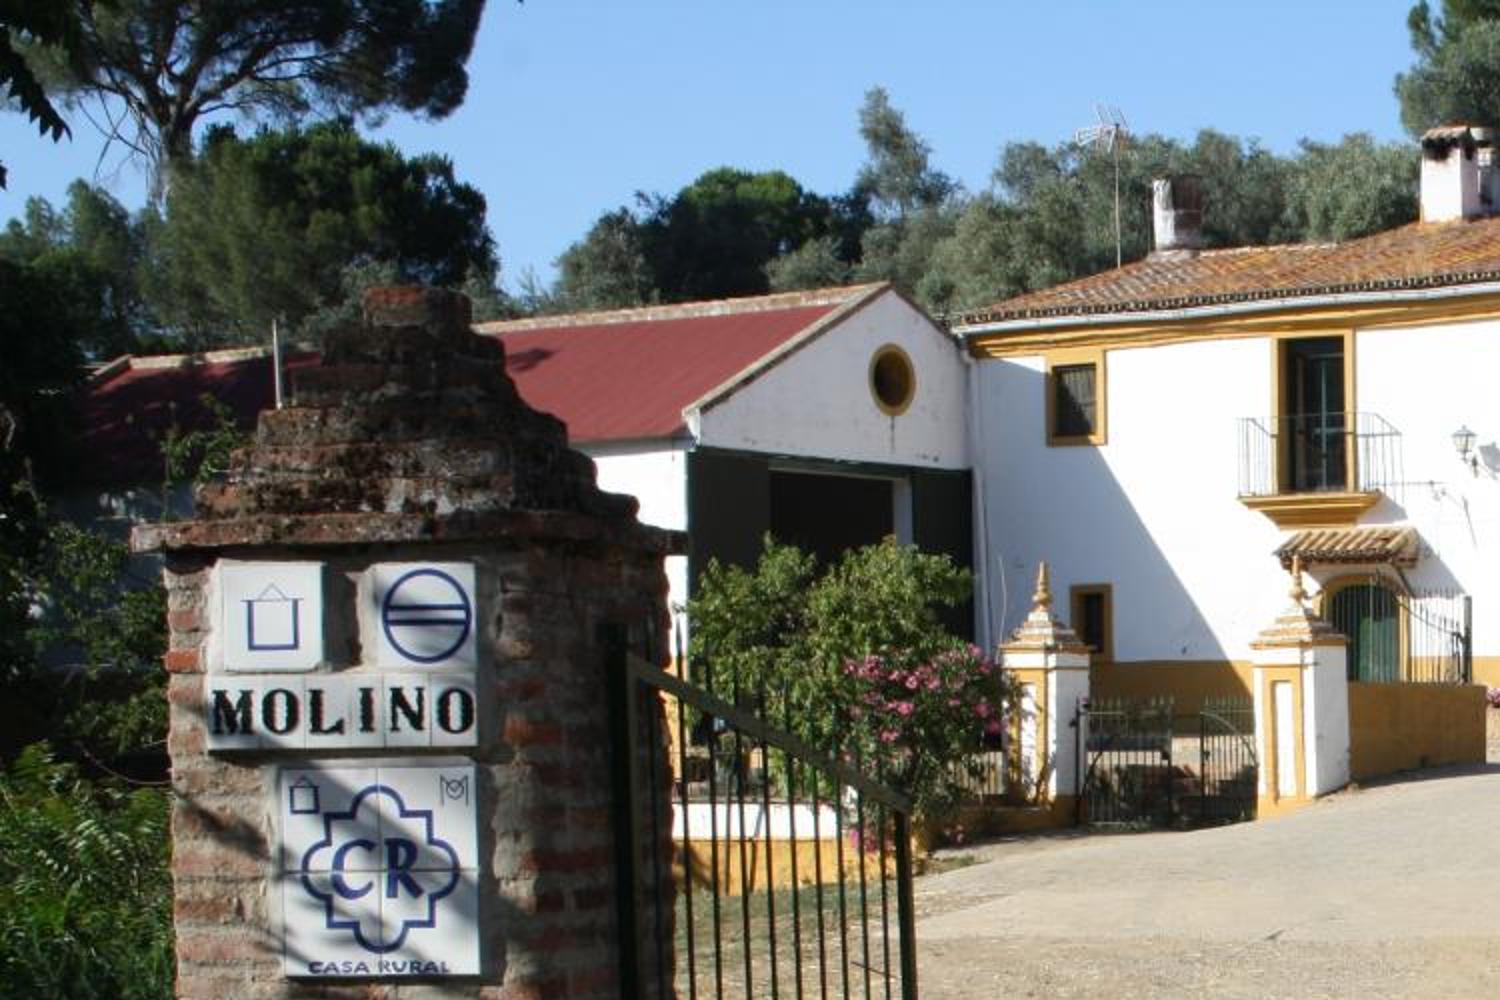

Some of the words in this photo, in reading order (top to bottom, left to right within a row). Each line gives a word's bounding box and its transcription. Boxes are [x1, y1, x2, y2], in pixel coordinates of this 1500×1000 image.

[211, 687, 475, 735] MOLINO
[331, 837, 424, 900] CR
[308, 961, 370, 974] CASA
[378, 961, 451, 974] RURAL
